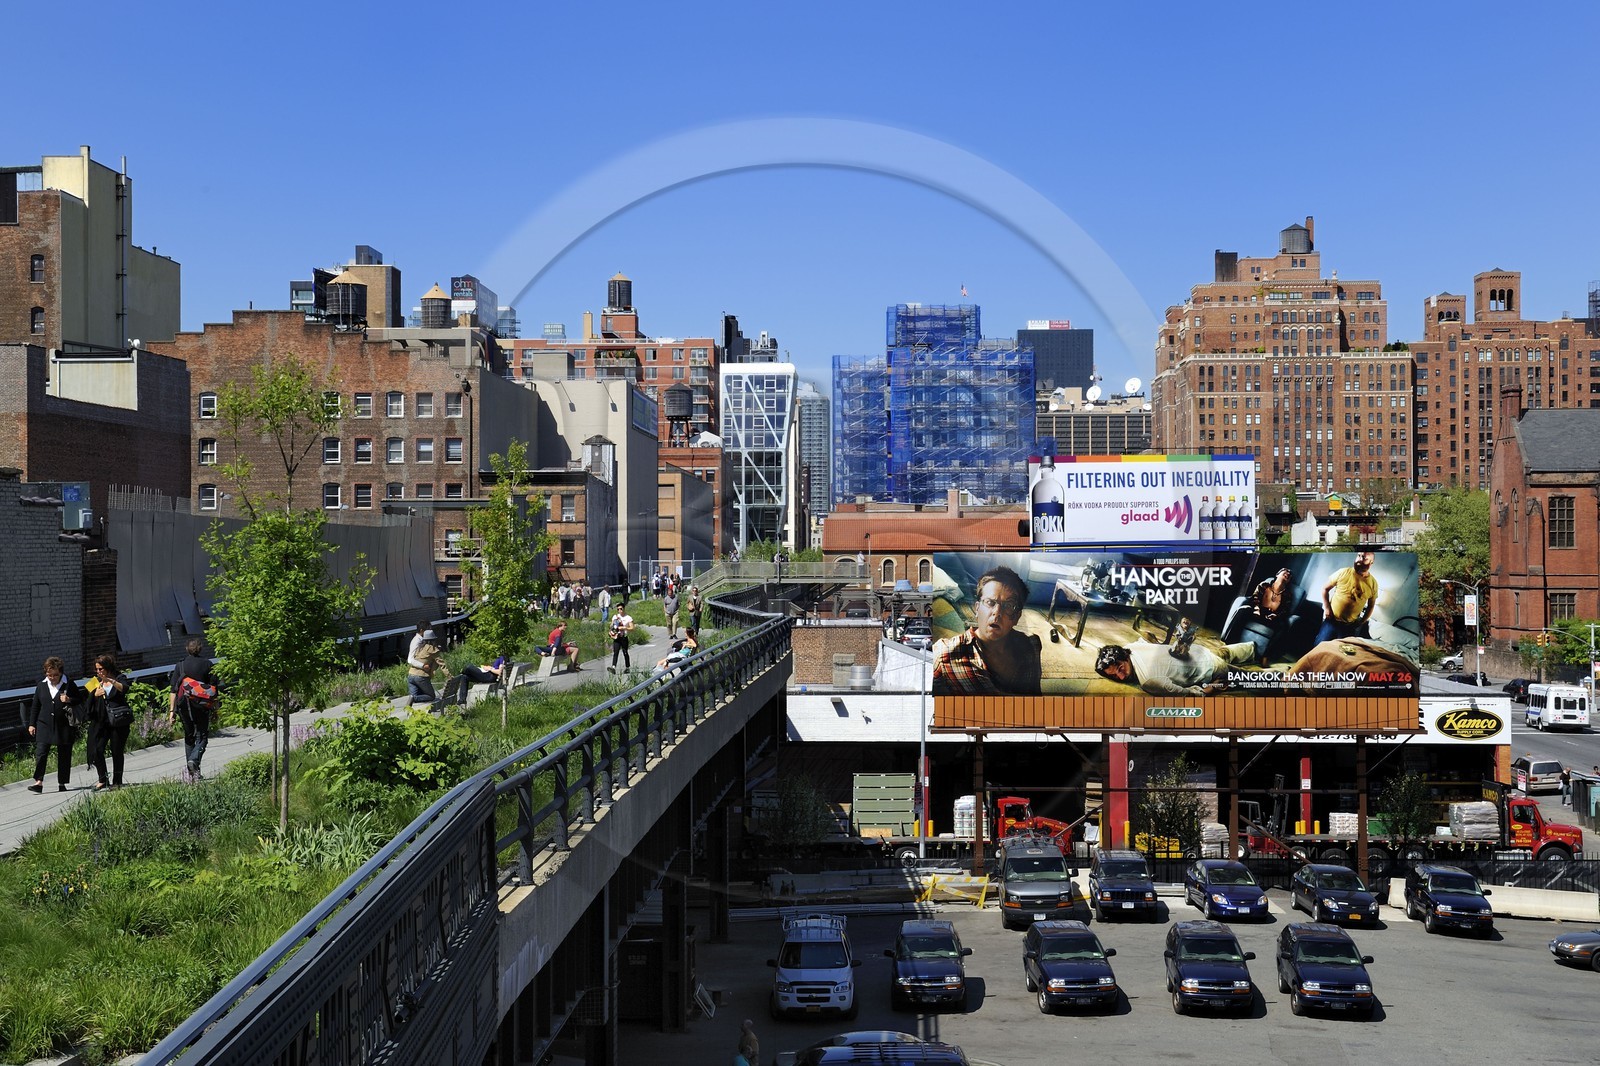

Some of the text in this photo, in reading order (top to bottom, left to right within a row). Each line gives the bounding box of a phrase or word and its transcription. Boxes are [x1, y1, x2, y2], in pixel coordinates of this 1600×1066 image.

[1067, 470, 1250, 489] FILTERING OUT INEQUALITY
[1083, 501, 1102, 509] VODKA
[1103, 501, 1129, 509] PROUDLY
[1130, 500, 1159, 509] SUPPORTS
[1121, 509, 1160, 525] glaad
[1111, 566, 1233, 587] HANGOVER
[1146, 588, 1198, 605] PART II
[1227, 671, 1412, 683] BANGKOK HAS THEM NOW MAY 26
[1444, 712, 1497, 730] Kamco
